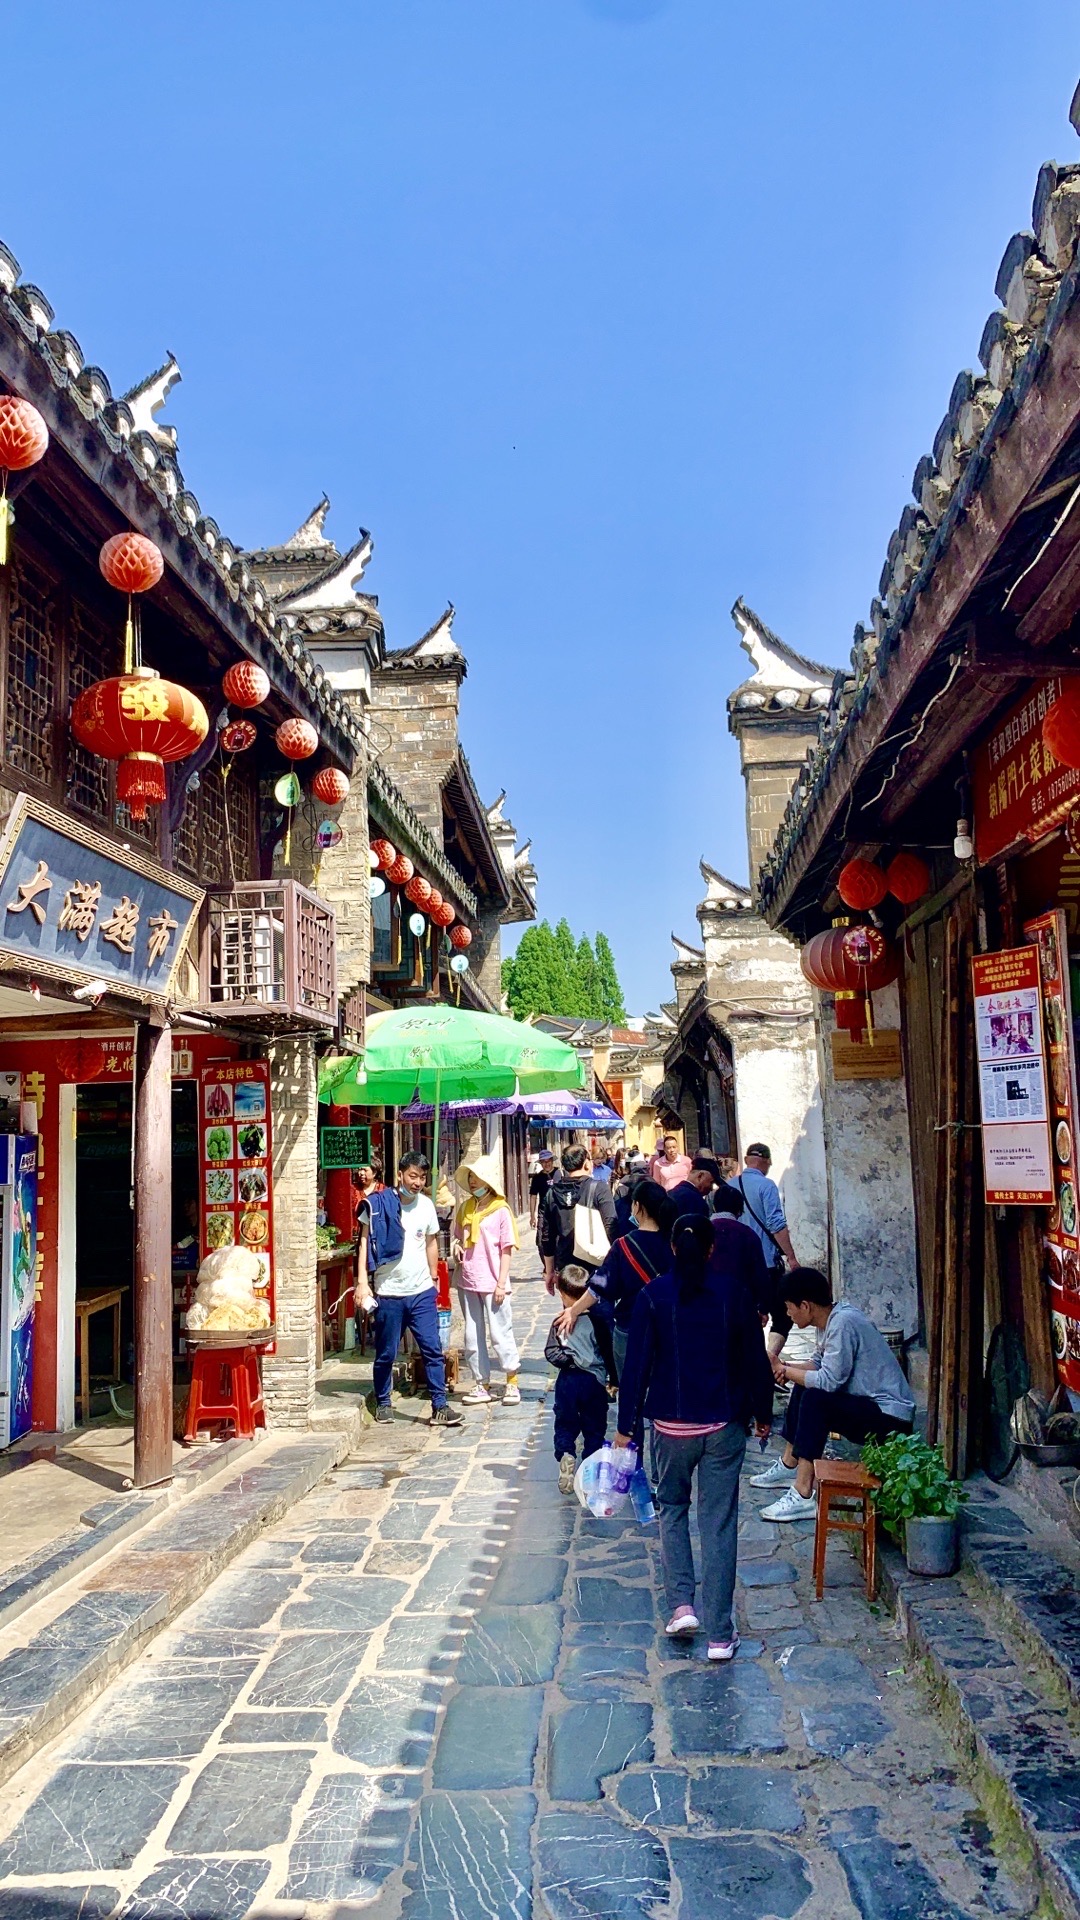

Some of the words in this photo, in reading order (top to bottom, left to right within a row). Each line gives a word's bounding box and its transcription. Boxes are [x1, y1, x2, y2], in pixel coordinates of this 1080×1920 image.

[7, 860, 179, 968] 大满超市
[100, 1041, 133, 1053] 酒开创者
[216, 1067, 255, 1081] 本店特色
